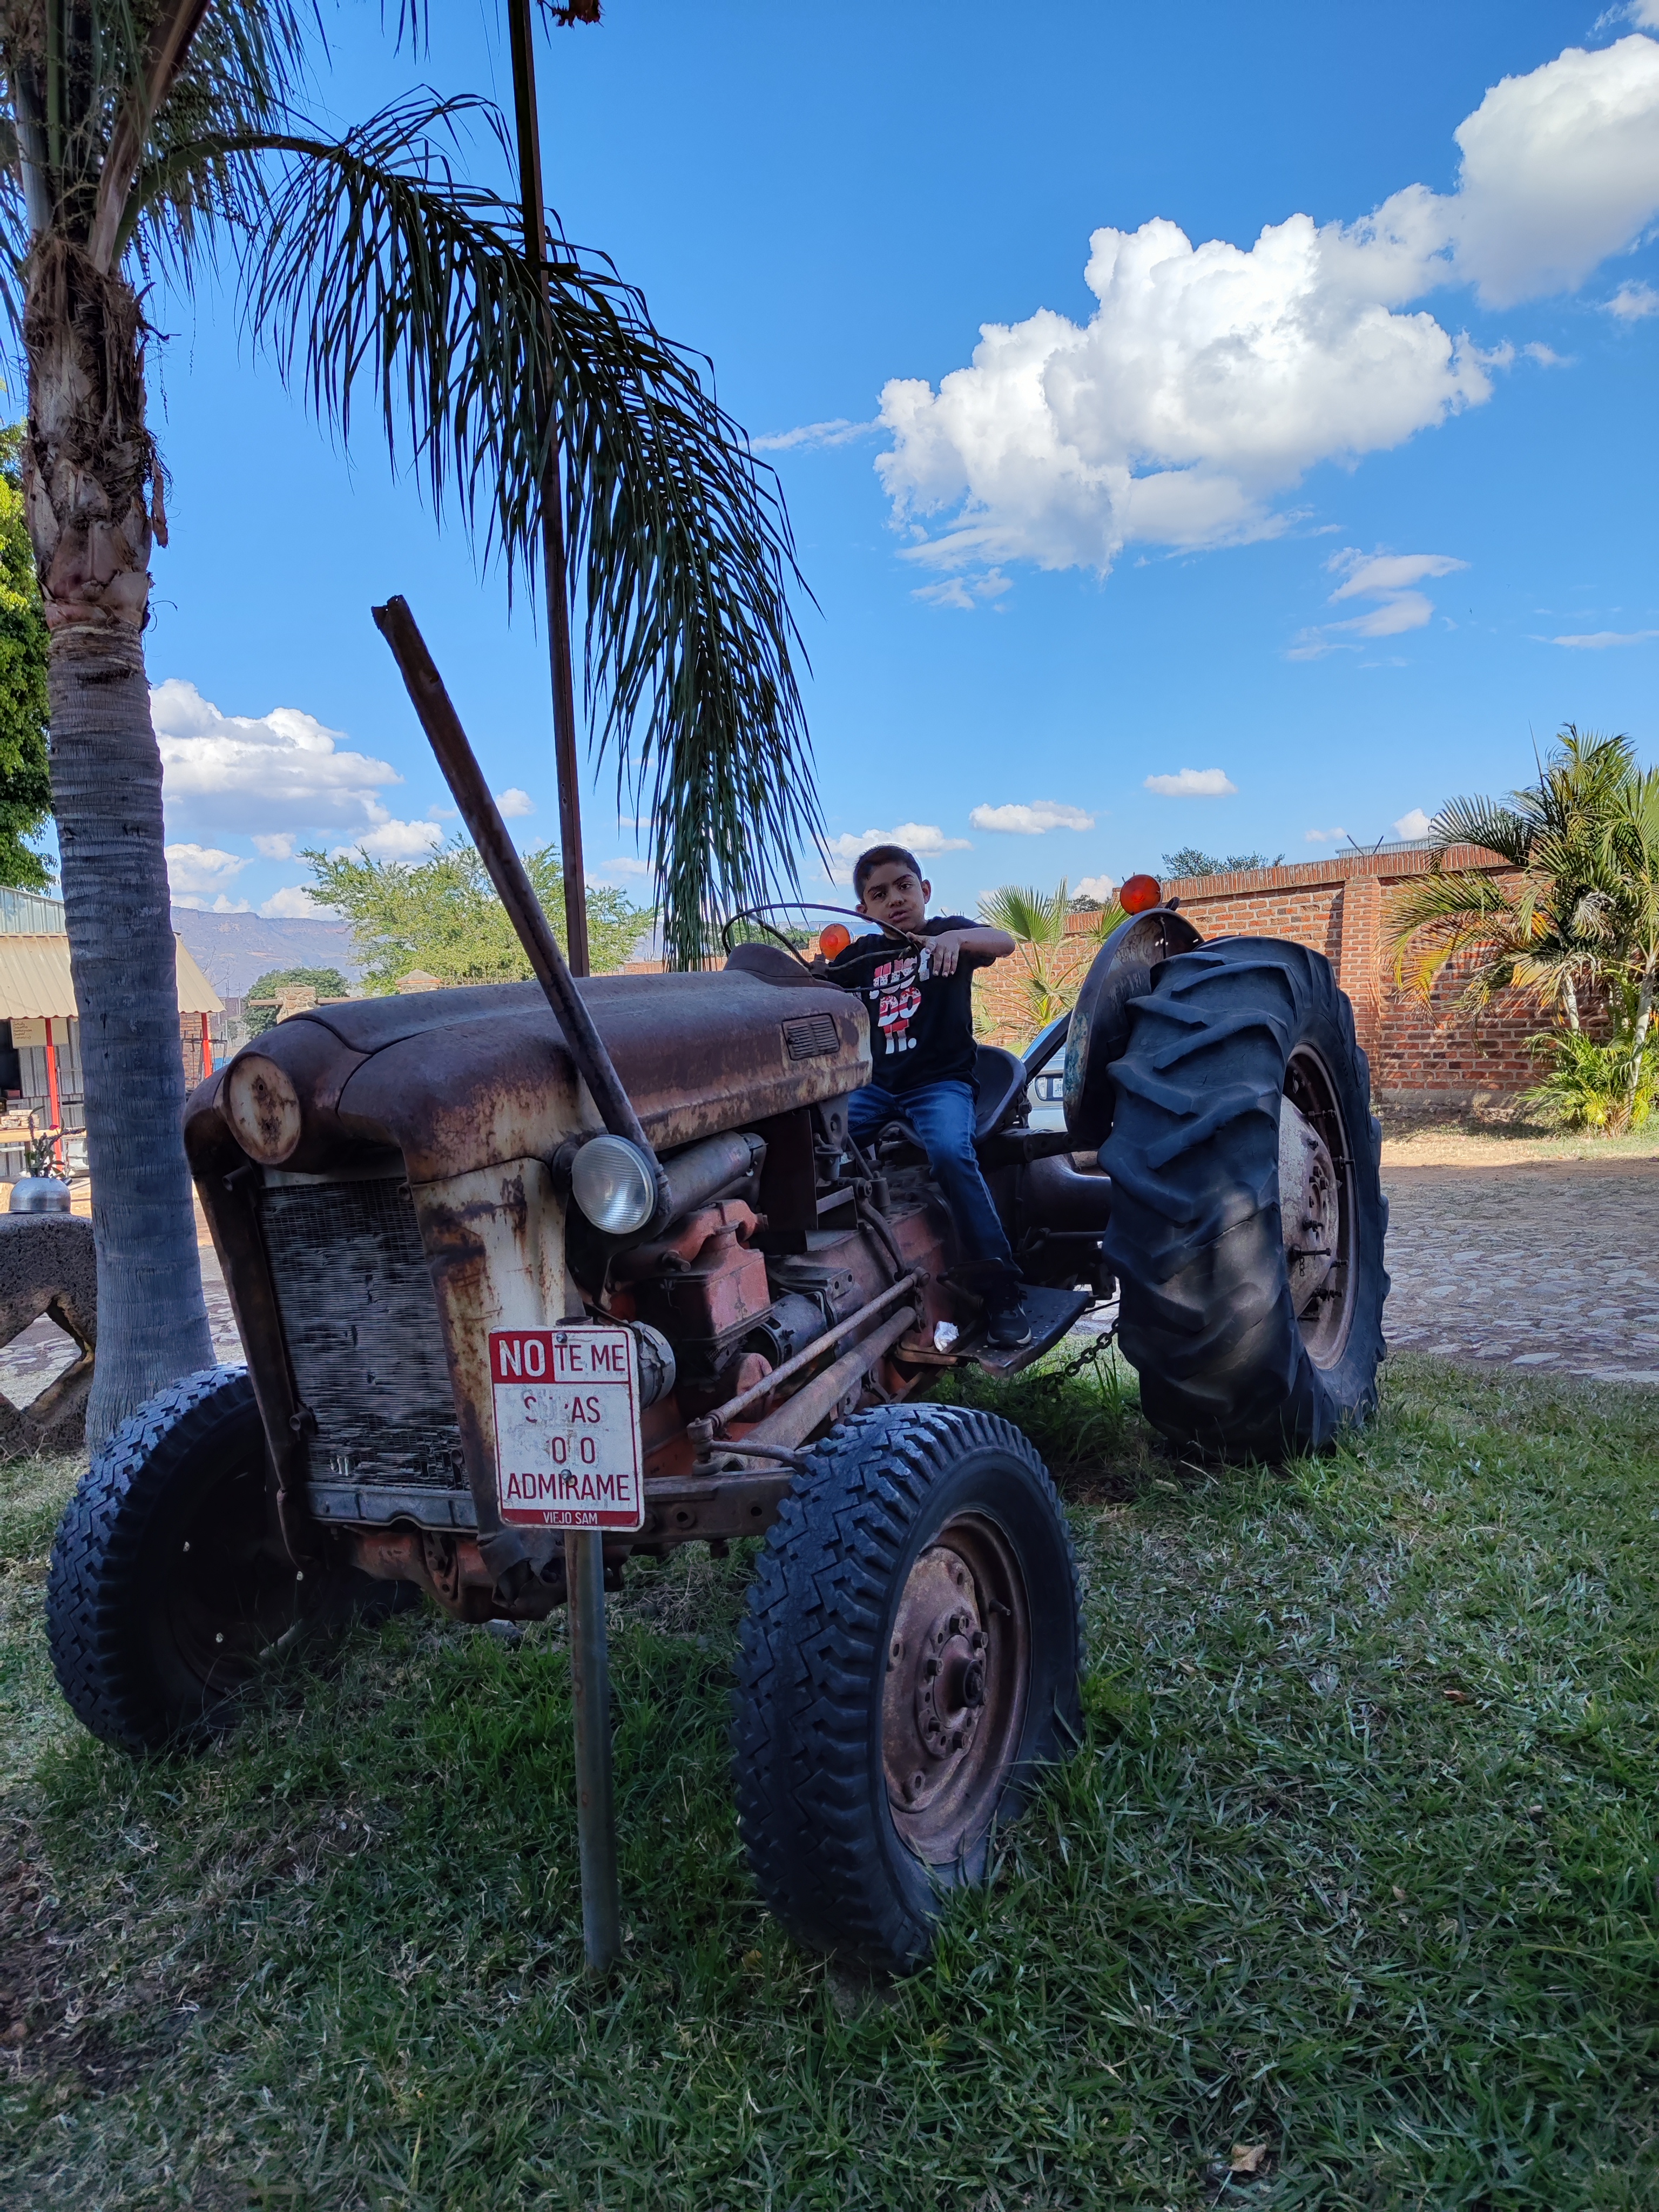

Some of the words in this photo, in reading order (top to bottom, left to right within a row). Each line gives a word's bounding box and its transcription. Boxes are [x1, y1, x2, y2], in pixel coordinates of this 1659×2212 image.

[878, 986, 921, 1027] DO
[884, 1019, 916, 1054] IT.
[499, 1339, 545, 1377] NO
[555, 1345, 583, 1371] TE
[591, 1344, 625, 1371] ME
[507, 1473, 630, 1501] ADMIRAME
[543, 1512, 571, 1524] VIEJO
[575, 1512, 598, 1525] SAM
